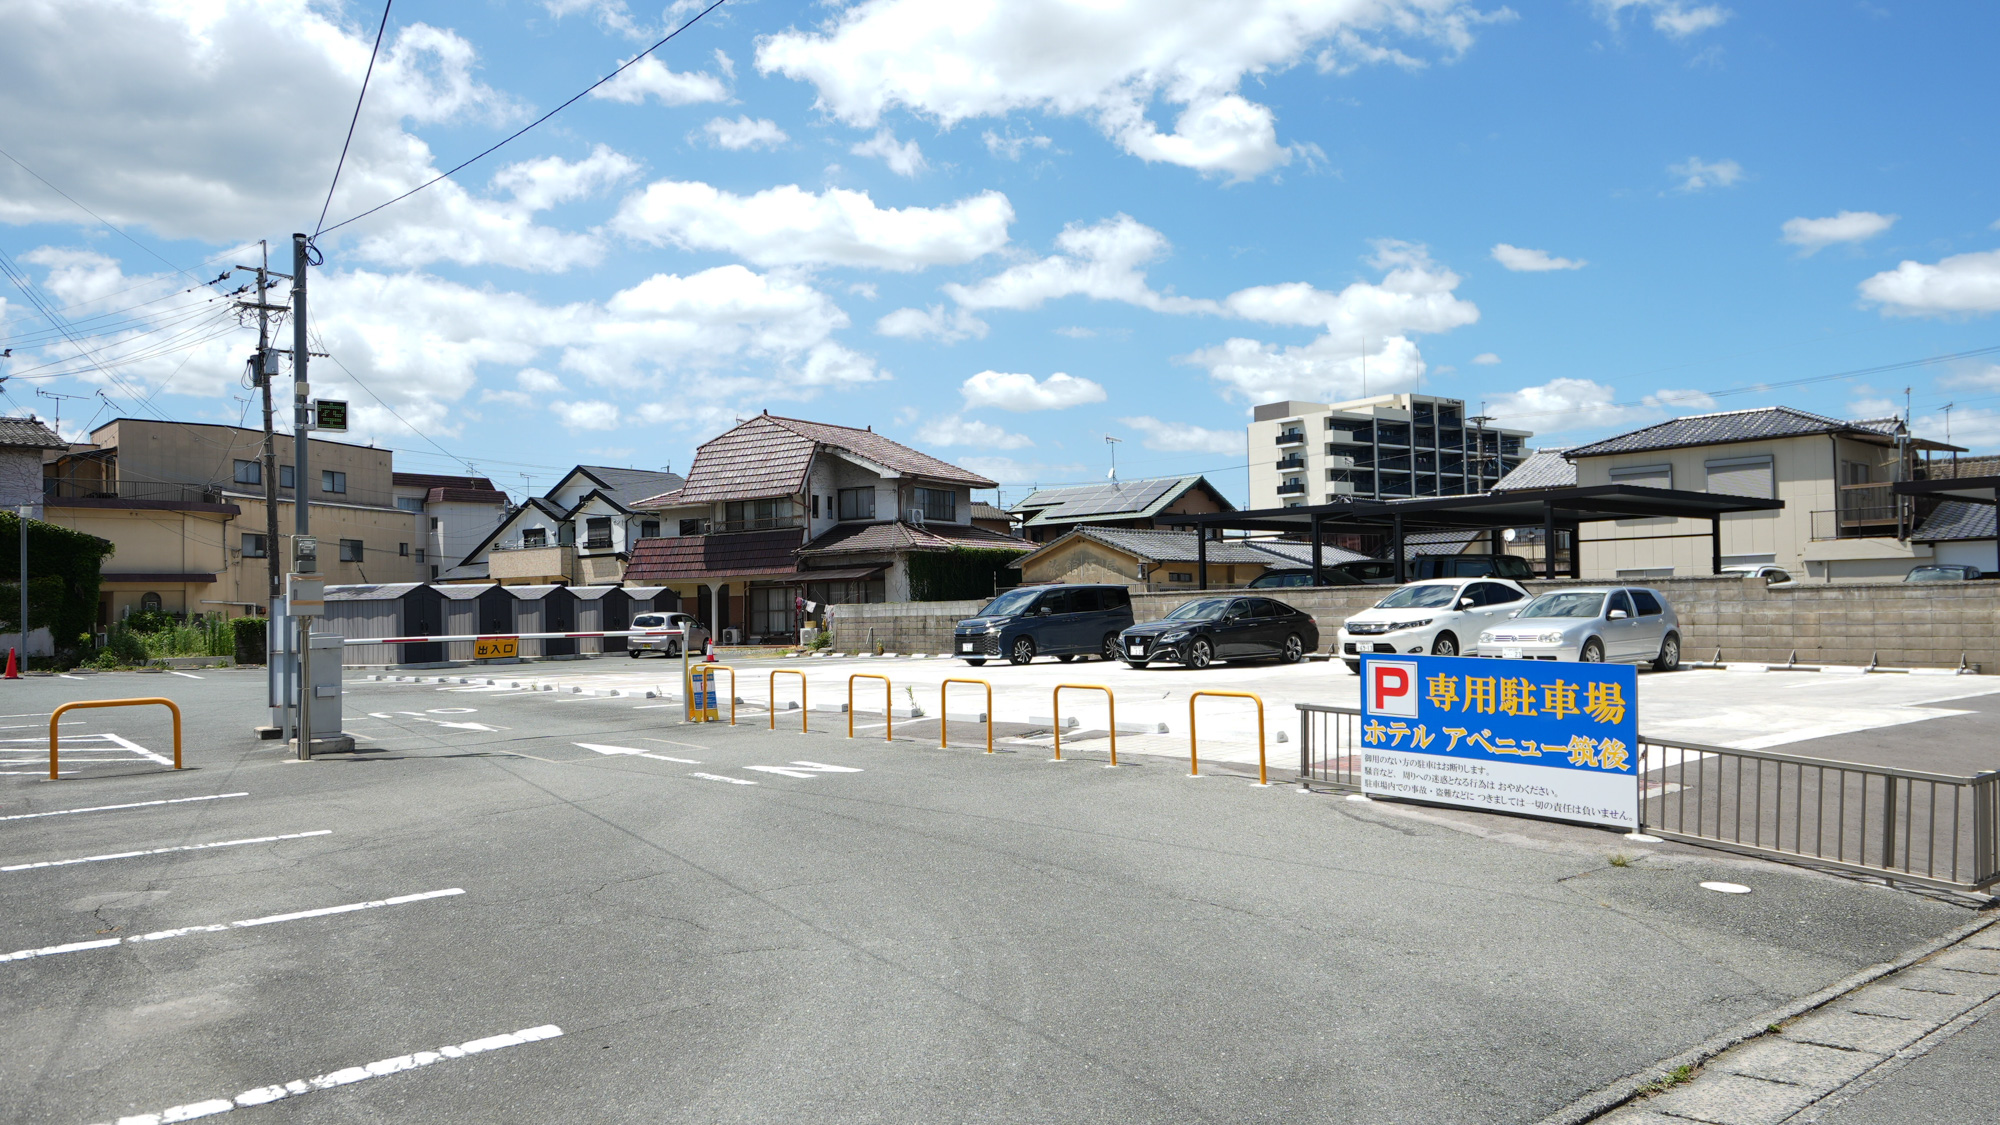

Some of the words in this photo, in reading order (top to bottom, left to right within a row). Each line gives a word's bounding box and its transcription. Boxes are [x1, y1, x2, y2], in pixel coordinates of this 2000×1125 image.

[477, 644, 514, 655] 出入口
[1375, 666, 1409, 709] P
[1425, 673, 1626, 725] 専用駐車場
